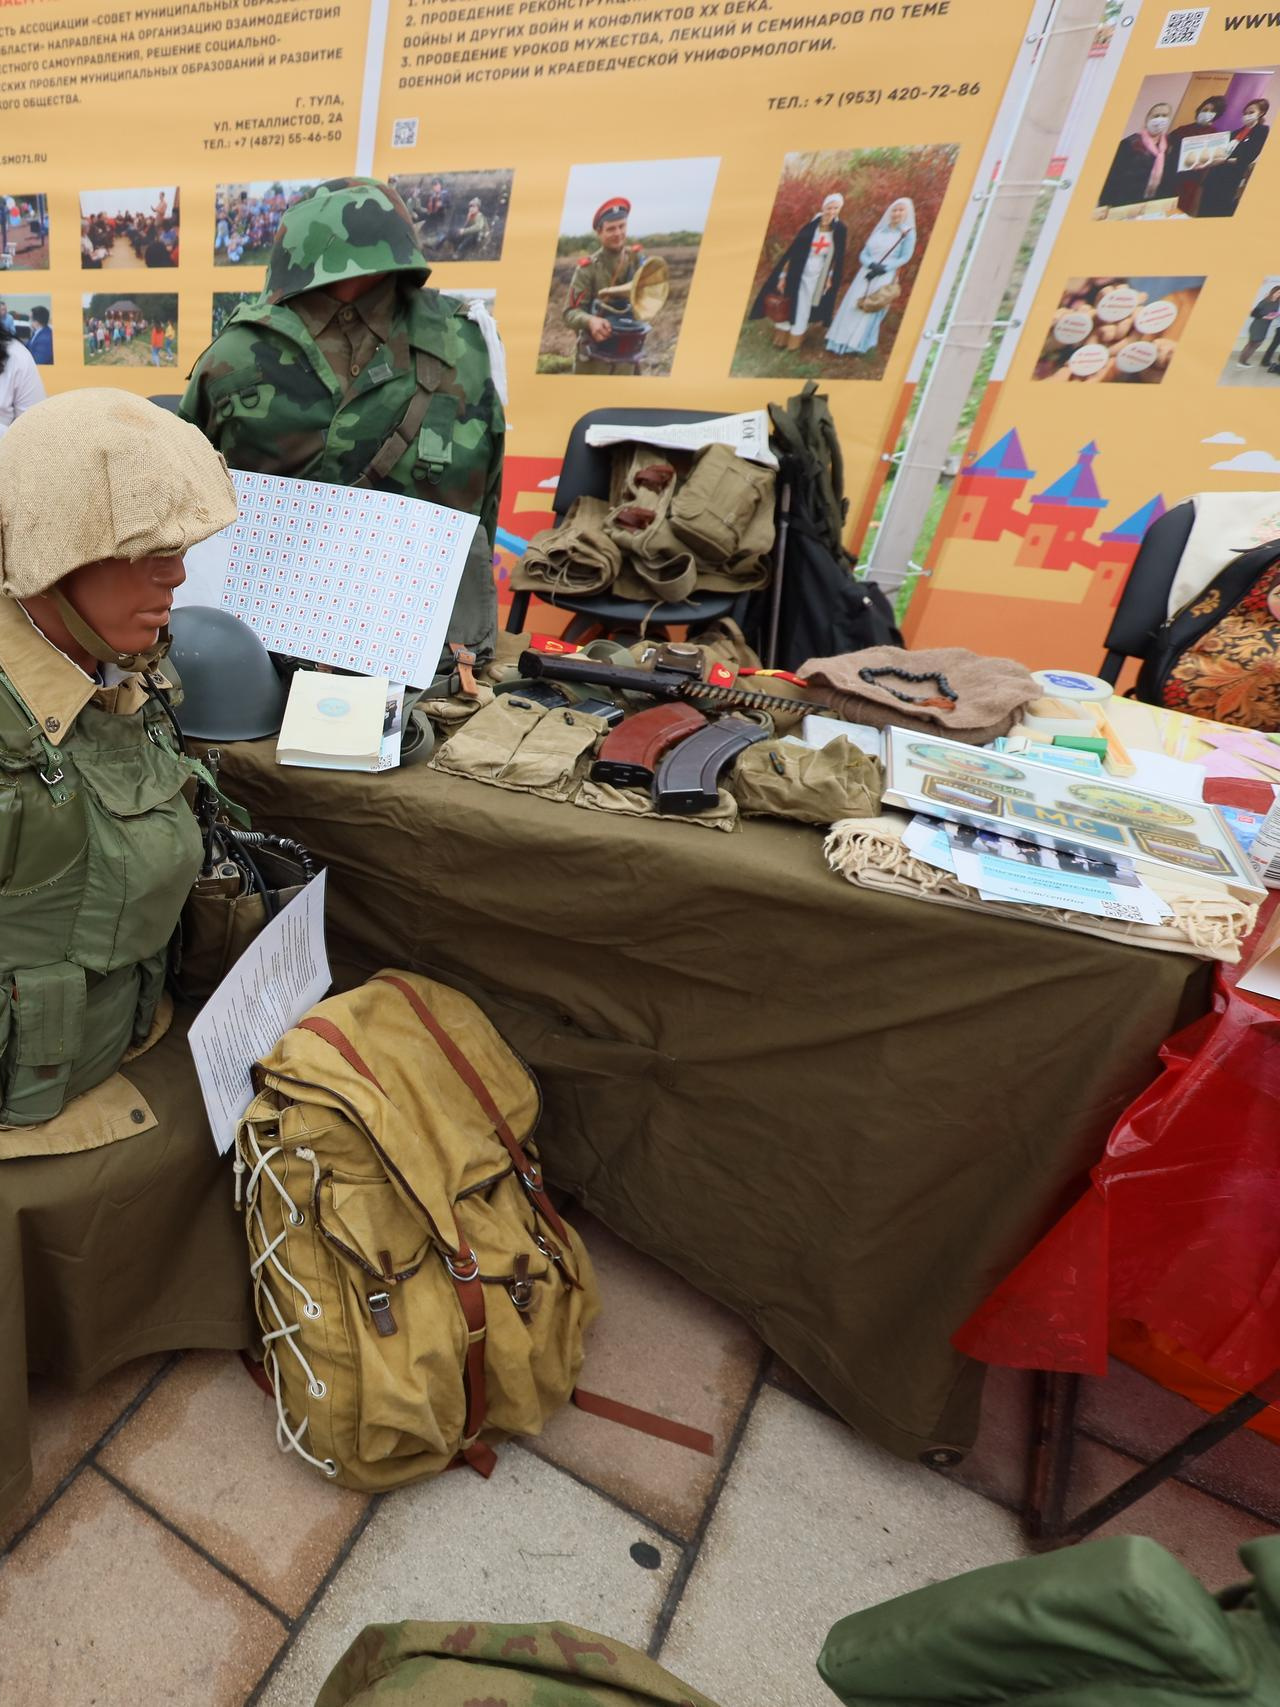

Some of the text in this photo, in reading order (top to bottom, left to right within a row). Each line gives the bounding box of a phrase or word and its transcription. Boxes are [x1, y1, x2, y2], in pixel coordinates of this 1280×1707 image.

[20, 17, 89, 34] АССОЦИАЦИИ
[135, 0, 240, 21] МУНИЦИПАЛЬНЫХ
[47, 34, 117, 50] НАПРАВЛЕНА
[120, 30, 135, 41] НА
[138, 20, 222, 40] ОРГАНИЗАЦИЮ
[226, 6, 341, 30] ВЗАИМОДЕЙСТВИЯ
[401, 1, 951, 67] 3. ПРОВЕДЕНИЕ УРОКОВ МУЖЕСТВА, ЛЕКЦИЙ И СЕМИНАРОВ ПО ТЕМЕ
[403, 33, 452, 49] ВОЙНЫ
[457, 31, 466, 42] И
[469, 24, 524, 42] ДРУГИХ
[528, 18, 569, 36] ВОЙН
[573, 18, 583, 30] И
[588, 8, 694, 30] КОНФЛИКТОВ
[723, 0, 773, 15] ВЕКА.
[405, 16, 416, 27] 2.
[421, 8, 514, 25] ПРОВЕДЕНИЕ
[29, 77, 77, 89] ПРОБЛЕМ
[80, 64, 178, 84] МУНИЦИПАЛЬНЫХ
[181, 55, 265, 75] ОБРАЗОВАНИЙ
[268, 54, 276, 65] И
[280, 48, 343, 64] РАЗВИТИЕ
[41, 50, 143, 70] САМОУПРАВЛЕНИЯ,
[147, 42, 201, 59] РЕШЕНИЕ
[205, 34, 281, 52] СОЦИАЛЬНО-
[399, 37, 837, 89] ВОЕННОЙ ИСТОРИИ И КРАЕВЕДЧЕСКОЙ УНИФОРМОЛОГИИ.
[23, 94, 82, 109] ОБЩЕСТВА.
[310, 94, 345, 107] ТУЛА,
[767, 82, 981, 111] ТЕЛ.: +7 (953) 420-72-86
[214, 121, 232, 132] УЛ.
[235, 113, 325, 131] МЕТАЛЛИСТОВ,
[203, 130, 342, 150] ТЕЛ.: +7 (4872) 55-46-50
